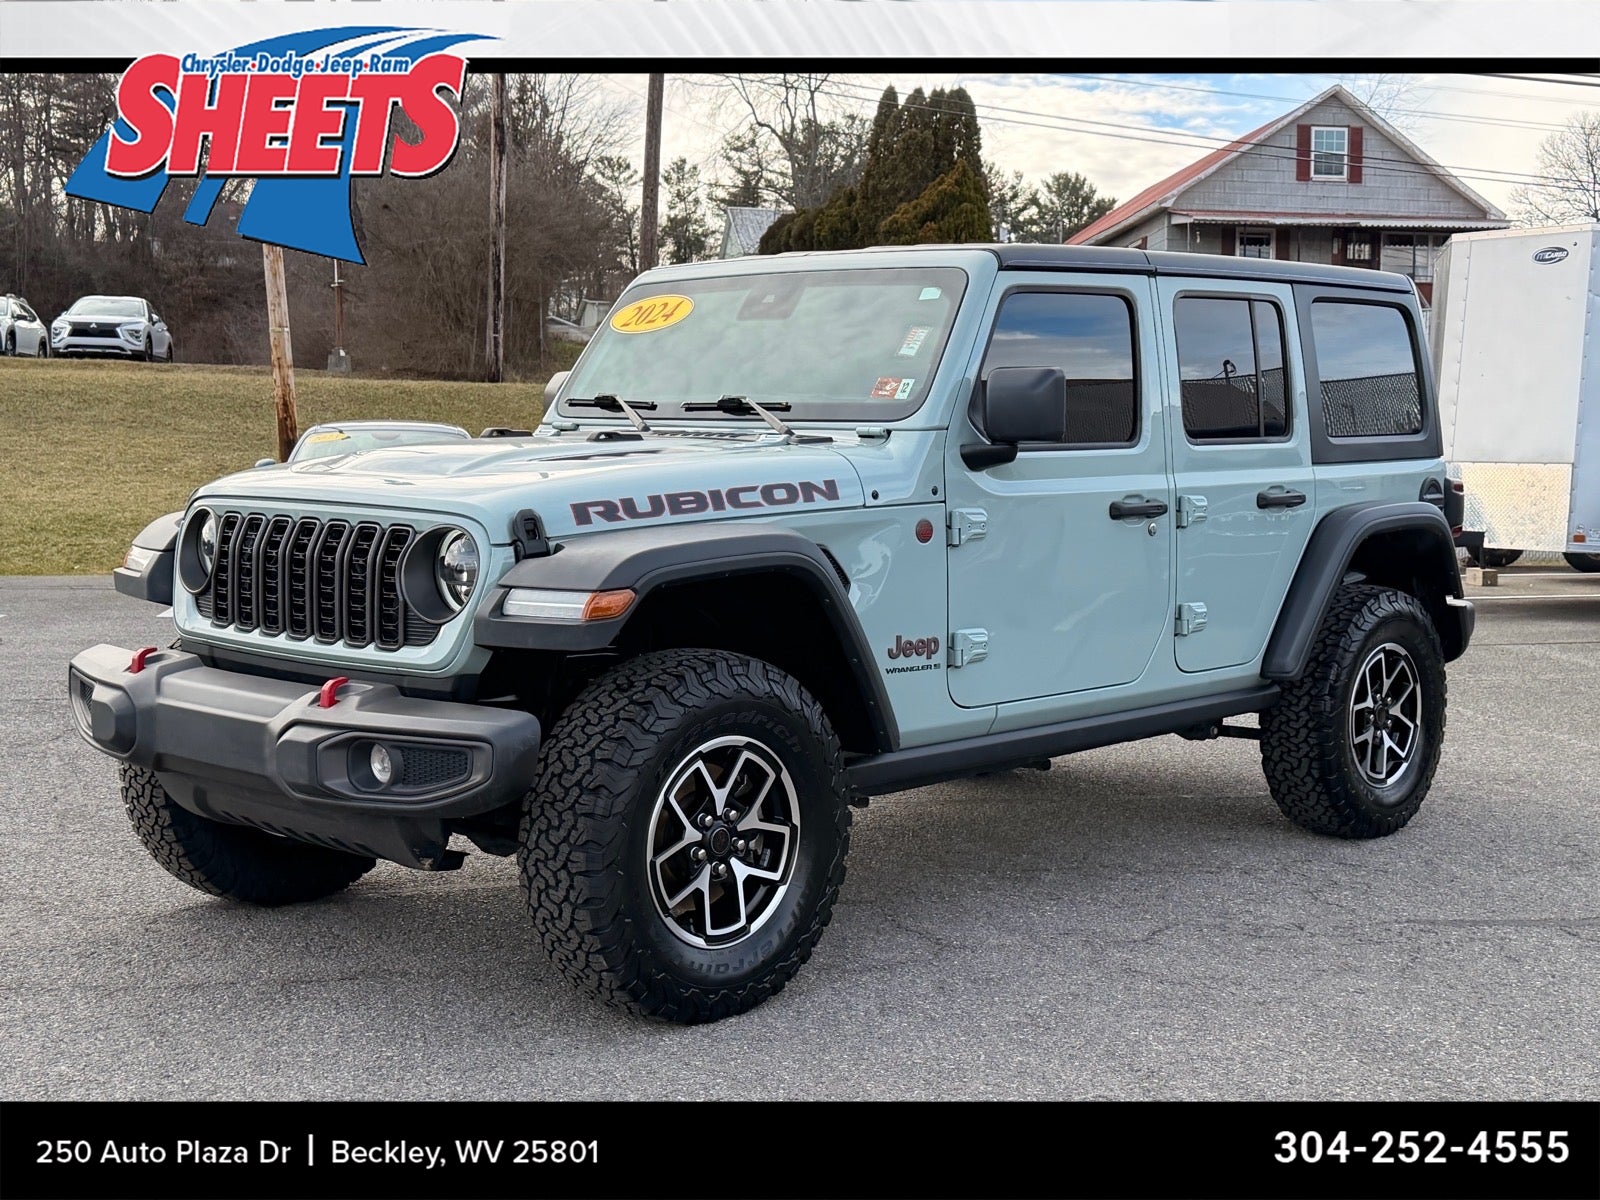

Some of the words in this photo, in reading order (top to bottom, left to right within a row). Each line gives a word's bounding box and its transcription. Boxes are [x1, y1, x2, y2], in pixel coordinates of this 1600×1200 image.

[619, 299, 686, 328] 2024
[569, 479, 840, 527] RUBICON
[887, 635, 940, 660] Jeep
[885, 664, 933, 675] WRANGLER
